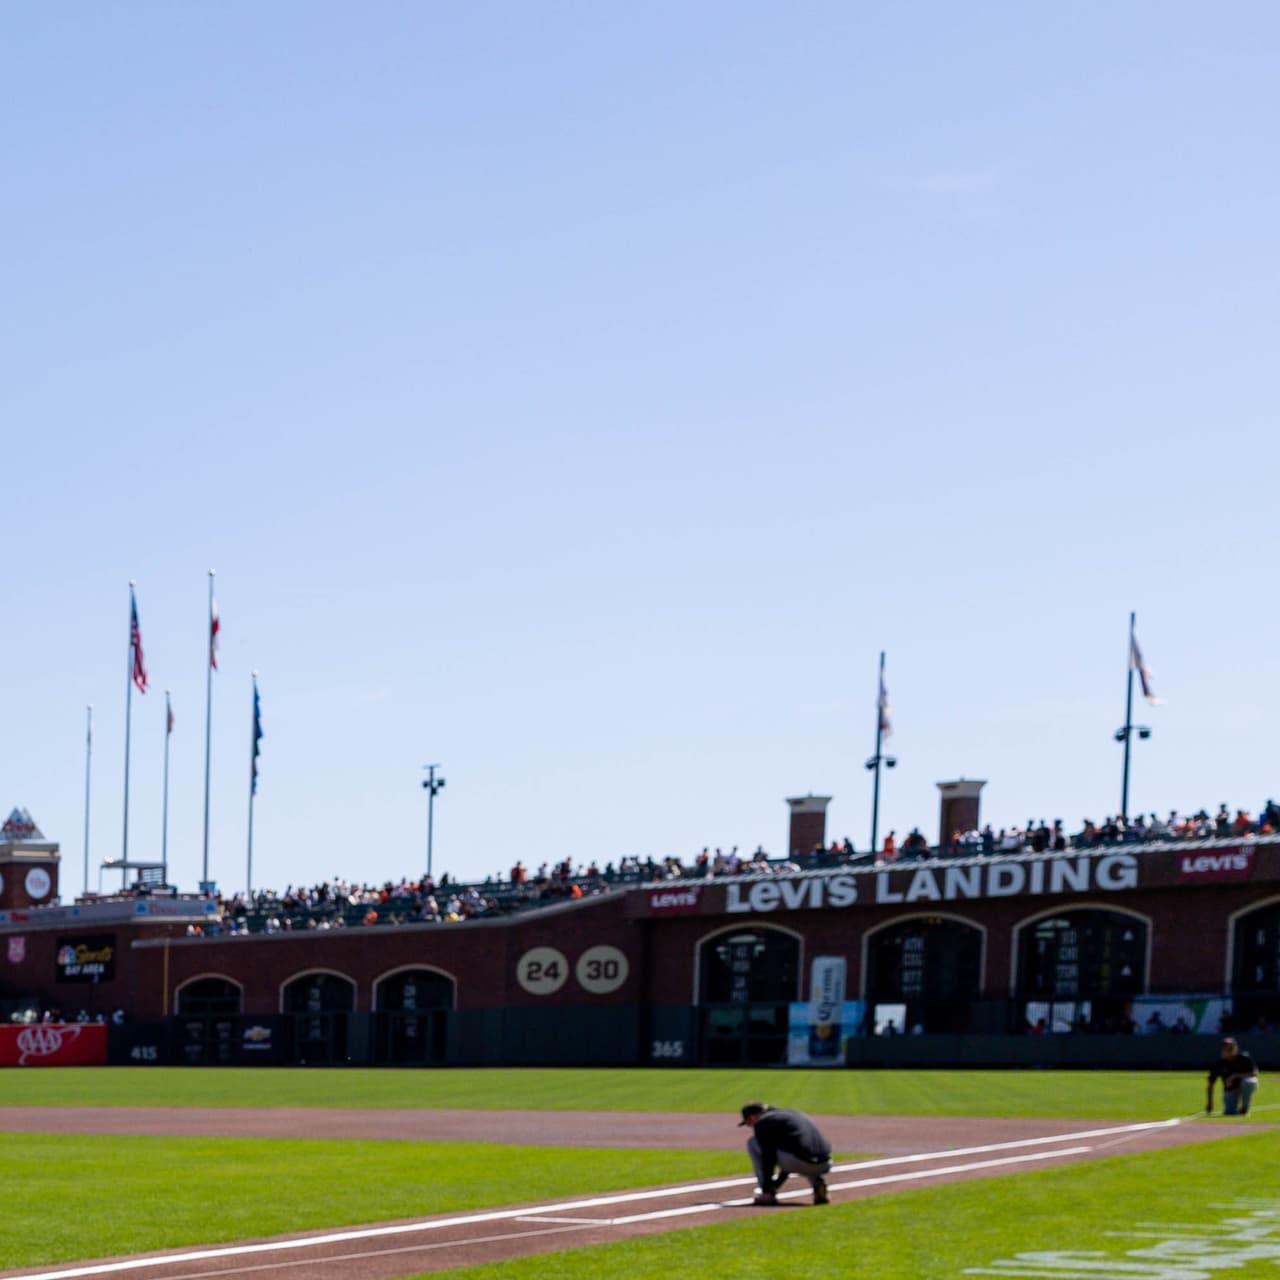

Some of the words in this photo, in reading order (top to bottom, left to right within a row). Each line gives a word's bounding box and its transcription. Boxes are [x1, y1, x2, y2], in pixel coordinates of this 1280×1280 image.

[876, 855, 1138, 904] LANDING
[526, 961, 559, 981] 24
[586, 960, 619, 980] 30
[131, 1046, 157, 1061] 415
[652, 1041, 683, 1058] 365
